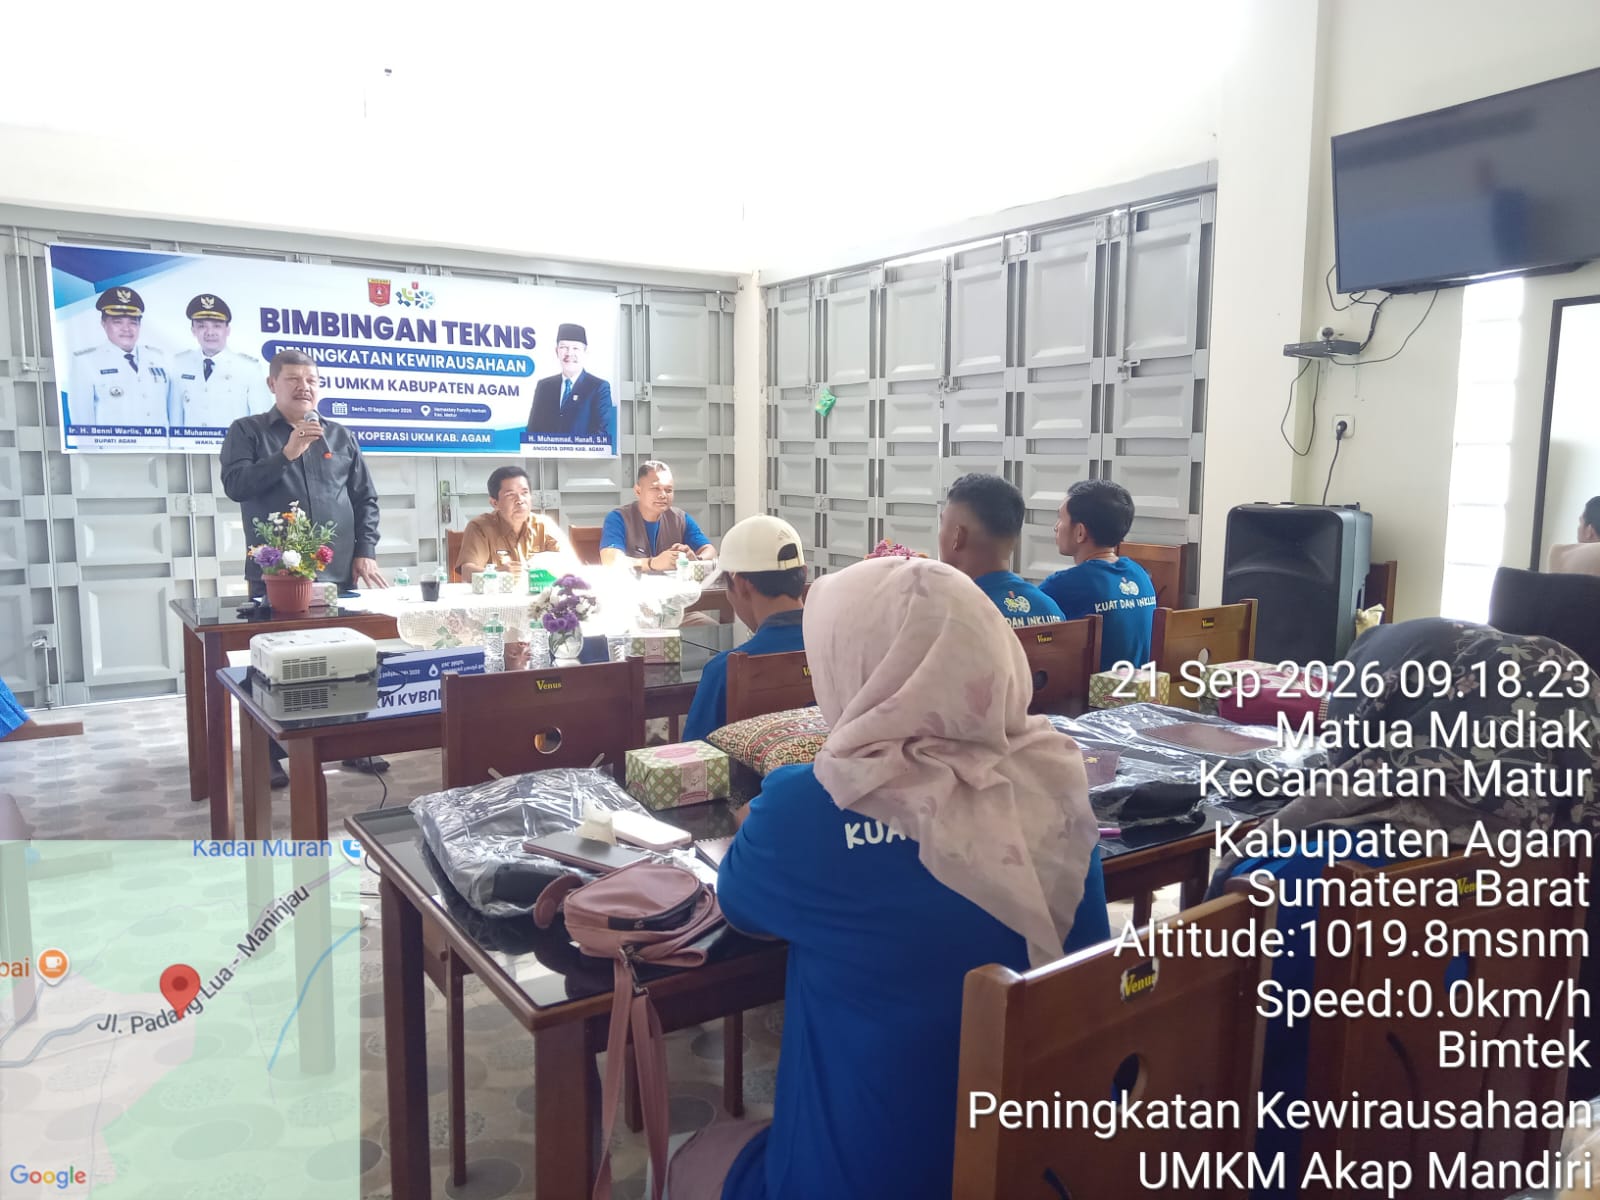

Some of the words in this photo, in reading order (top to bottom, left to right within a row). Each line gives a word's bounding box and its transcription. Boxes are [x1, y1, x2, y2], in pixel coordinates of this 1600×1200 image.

[259, 307, 437, 344] BIMBINGAN
[441, 320, 537, 350] TEKNIS
[396, 352, 527, 373] KEWIRAUSAHAAN
[335, 377, 384, 391] UMKM
[388, 379, 475, 395] KABUPATEN
[478, 383, 520, 397] AGAM
[358, 431, 409, 442] KOPERASI
[411, 432, 434, 442] UKM
[436, 434, 459, 443] KAB.
[461, 434, 491, 443] AGAM
[1094, 599, 1118, 613] KUAT
[1119, 599, 1135, 609] DAN
[536, 679, 562, 691] Venus
[845, 820, 906, 849] KUA
